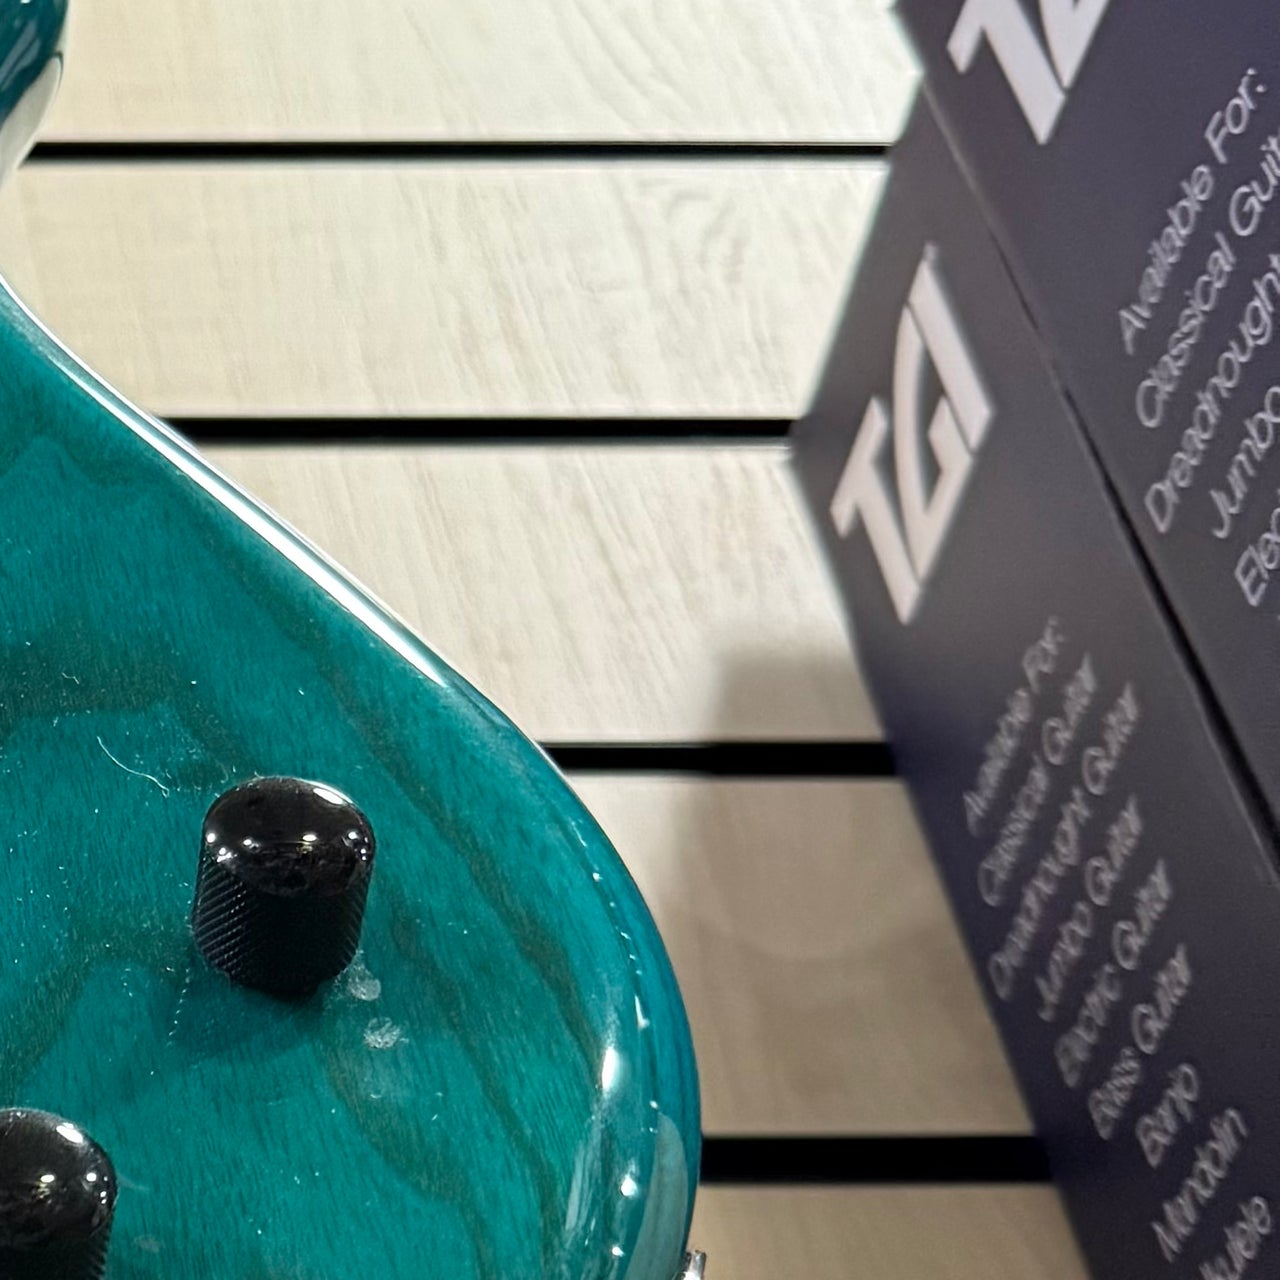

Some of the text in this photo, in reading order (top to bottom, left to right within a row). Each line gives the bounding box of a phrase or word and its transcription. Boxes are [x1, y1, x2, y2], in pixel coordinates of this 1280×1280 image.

[1119, 68, 1267, 355] Available For:
[1136, 135, 1280, 427] Classical Guit
[830, 260, 996, 625] TGI
[1209, 386, 1280, 538] Jumbo
[962, 616, 1065, 838] Available For:
[977, 652, 1097, 906] Classical Guitar
[989, 681, 1140, 1000] Dreadnought Guitar
[1034, 794, 1142, 1021] Jumbo Guitar
[1054, 858, 1172, 1088] Electric Guitar
[1089, 942, 1191, 1140] Bass Guitar
[1135, 1063, 1199, 1169] Banjo
[1151, 1107, 1248, 1263] Mandolin
